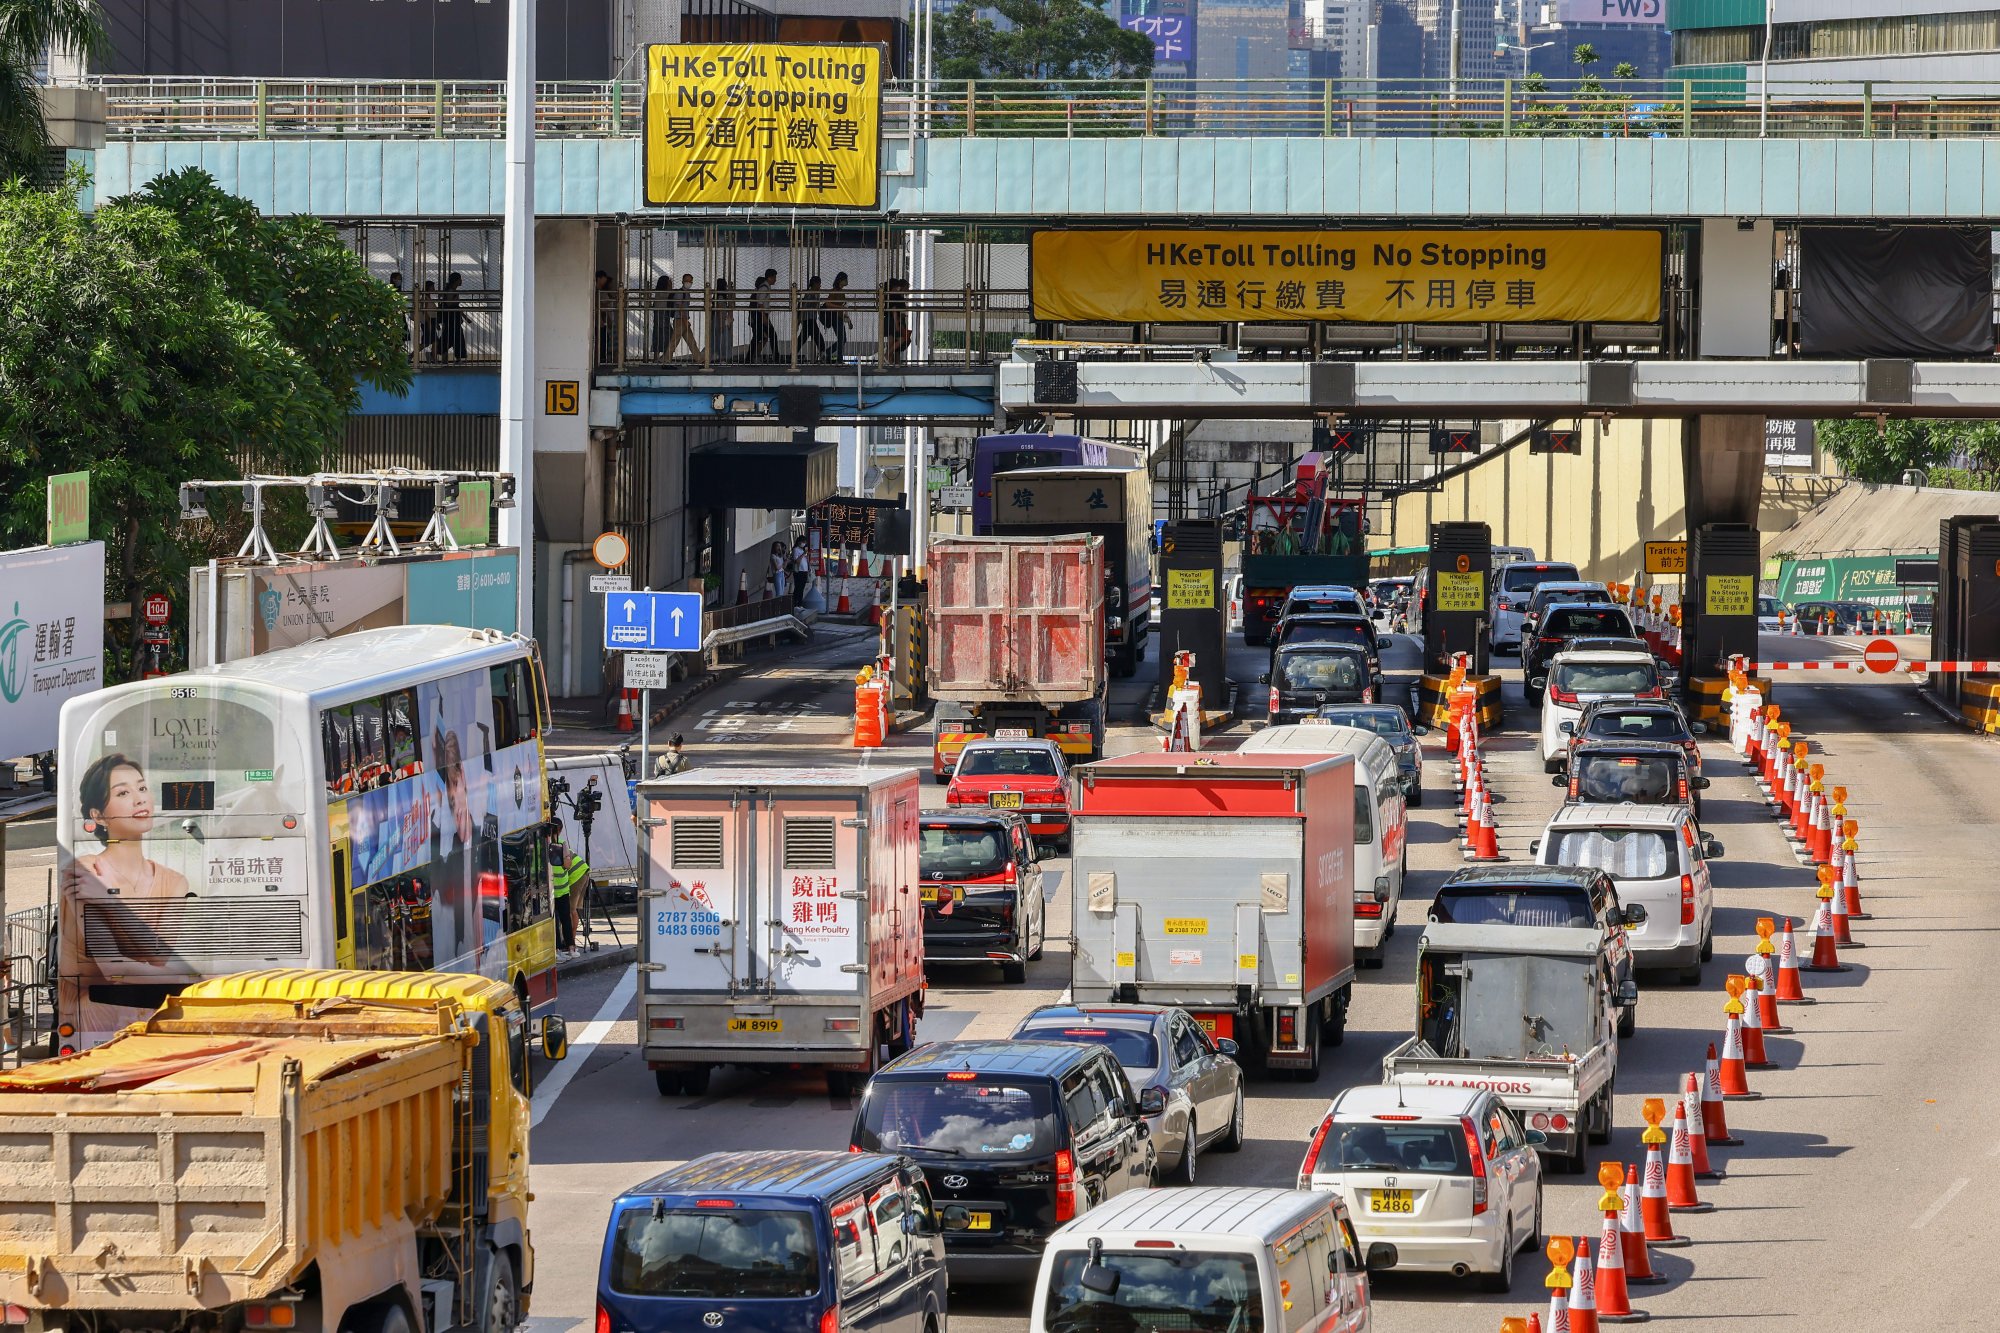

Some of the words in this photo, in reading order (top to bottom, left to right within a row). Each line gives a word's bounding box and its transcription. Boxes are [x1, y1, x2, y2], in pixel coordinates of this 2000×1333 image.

[1127, 16, 1182, 36] イオン
[661, 56, 768, 78] HKeToll
[775, 57, 866, 84] Tolling
[677, 85, 716, 108] No
[724, 84, 848, 114] Stopping
[665, 116, 859, 151] 易通行繳費
[686, 159, 838, 193] 不用停車
[1147, 243, 1256, 267] HKeToll
[1262, 244, 1356, 271] Tolling
[1373, 243, 1412, 266] No
[1420, 242, 1547, 270] Stopping
[1157, 279, 1347, 310] 易通行繳費
[1385, 278, 1537, 310] 不用停車
[550, 383, 576, 412] 15
[54, 480, 87, 528] POAD
[1648, 546, 1678, 554] Traffic
[1661, 556, 1684, 568] 前方
[150, 603, 165, 614] 104
[283, 613, 304, 627] UNION
[306, 610, 334, 625] HOSPITAL
[33, 616, 76, 663] 運輸署
[150, 644, 160, 653] A2
[33, 672, 61, 696] Transport
[61, 666, 96, 692] Department
[171, 688, 198, 698] 9518
[153, 717, 208, 737] LOVE
[997, 729, 1026, 737] TAXI
[172, 733, 219, 751] Beauty
[172, 782, 205, 809] 171
[208, 856, 284, 876] 六福珠寶
[243, 876, 283, 884] JEWELLERY
[792, 875, 838, 898] 鏡記
[657, 911, 687, 923] 2787
[690, 911, 720, 923] 3506
[792, 901, 838, 924] 雞鴨
[657, 924, 688, 936] 9483
[690, 924, 720, 936] 6966
[804, 925, 821, 934] Kee
[822, 925, 850, 935] Poultry
[731, 1020, 747, 1030] JM
[751, 1020, 779, 1031] 8919
[1461, 1080, 1532, 1094] MOTORS
[1382, 1189, 1401, 1200] WM
[1372, 1201, 1411, 1211] 5486
